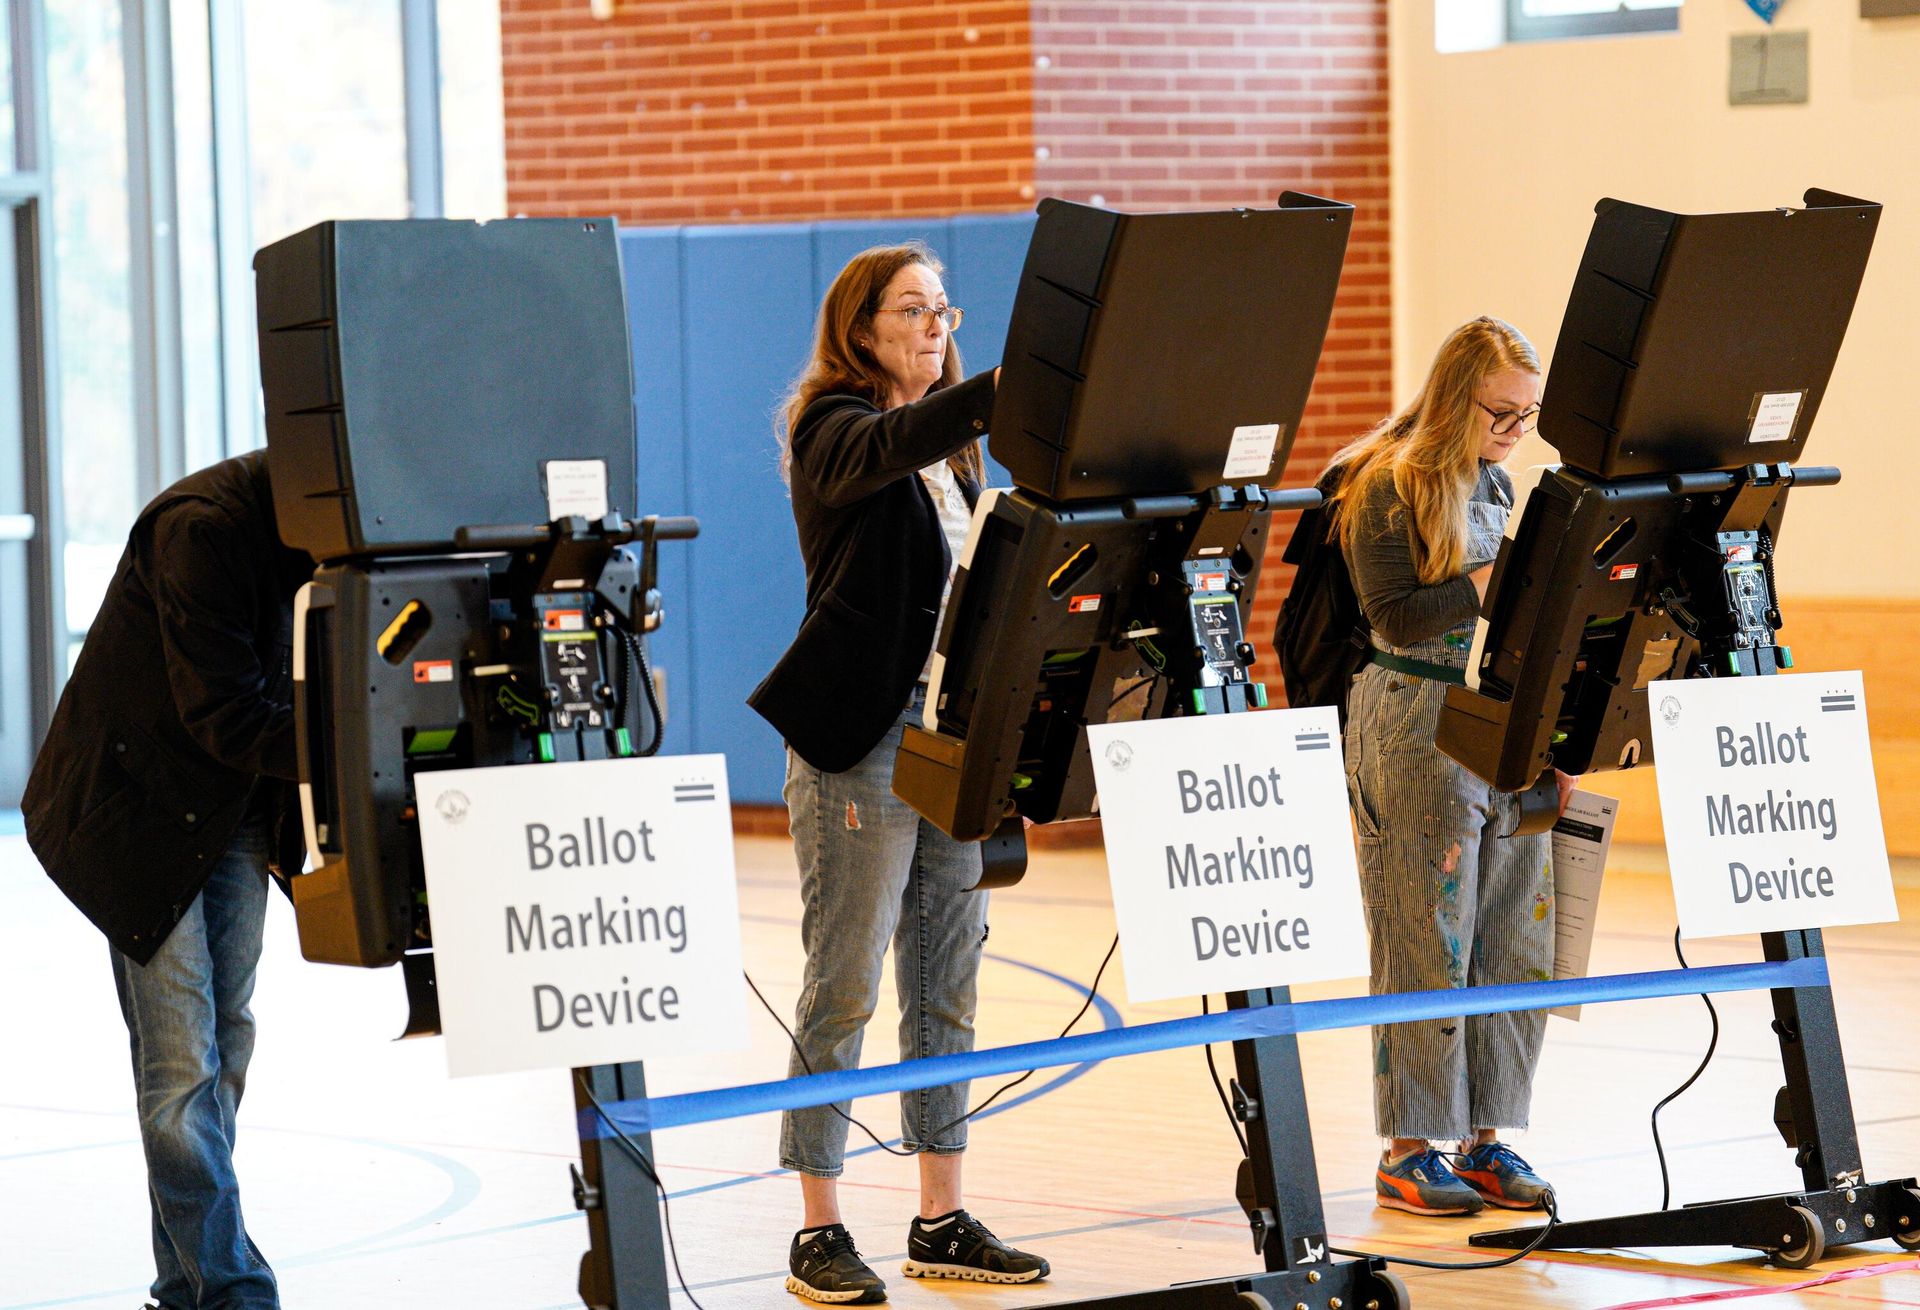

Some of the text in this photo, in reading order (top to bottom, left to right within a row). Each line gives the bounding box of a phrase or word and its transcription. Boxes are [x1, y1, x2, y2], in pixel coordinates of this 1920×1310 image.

[1715, 721, 1810, 768] Ballot
[1177, 763, 1284, 814] Ballot
[1706, 789, 1838, 841] Marking
[525, 815, 657, 871] Ballot
[1165, 835, 1314, 890] Marking
[1728, 857, 1834, 905] Device
[505, 896, 688, 954] Marking
[1191, 909, 1310, 961] Device
[533, 976, 680, 1033] Device
